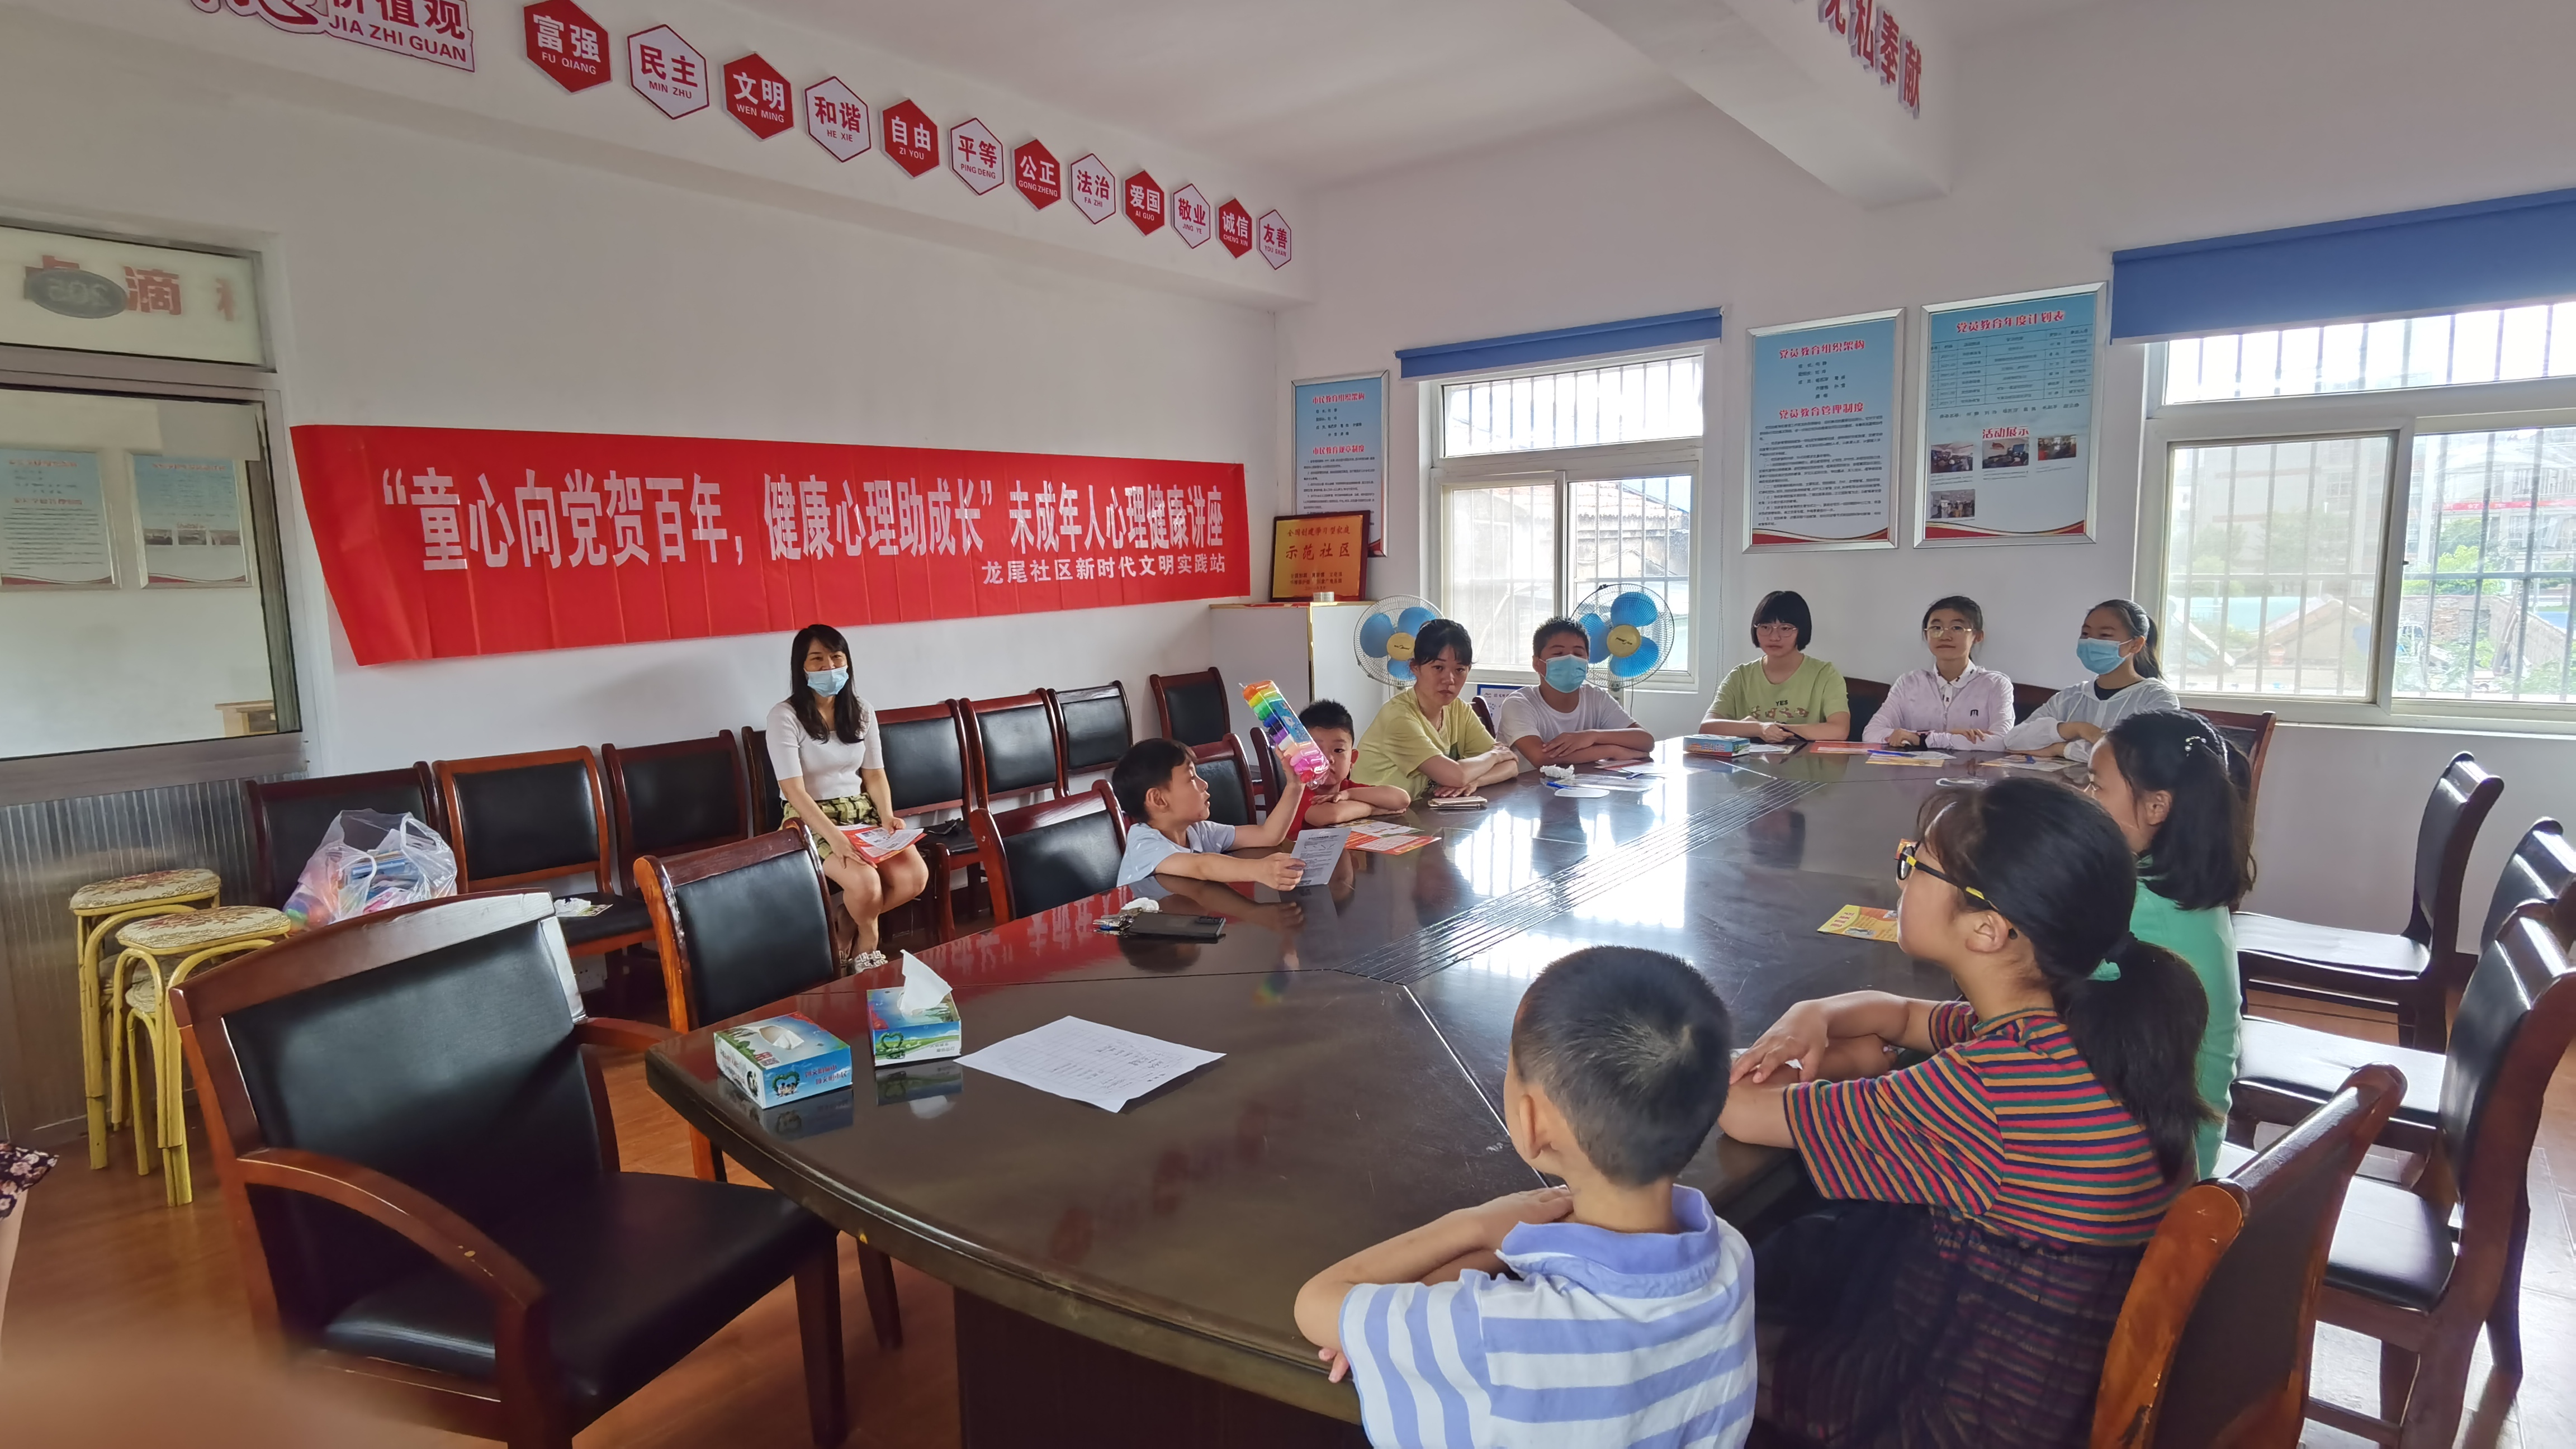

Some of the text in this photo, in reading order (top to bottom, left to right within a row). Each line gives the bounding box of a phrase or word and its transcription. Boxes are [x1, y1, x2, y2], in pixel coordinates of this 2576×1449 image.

[329, 15, 466, 62] JIA ZHI GUAN
[533, 14, 601, 63] 富强
[542, 52, 596, 75] FU QIANG
[640, 44, 698, 87] 民主
[649, 80, 692, 99] MIN ZHU
[733, 72, 785, 111] 文明
[736, 104, 784, 123] WEN MING
[814, 96, 861, 133] 和谐
[827, 129, 853, 143] HE XIE
[892, 116, 931, 152] 自由
[899, 148, 924, 160] ZI YOU
[958, 134, 997, 169] 平等
[960, 163, 996, 179] PING DENG
[1020, 155, 1056, 186] 公正
[1019, 179, 1058, 197] GONG ZHENG
[1077, 169, 1110, 200] 法治
[1093, 199, 1103, 207] ZHI
[1130, 184, 1161, 214] 爱国
[1178, 198, 1206, 226] 敬业
[1182, 224, 1194, 233] JING
[1222, 211, 1249, 239] 诚信
[1263, 224, 1287, 249] 友善
[1223, 234, 1239, 244] CHENG
[1957, 310, 2065, 333] 党员教育年度计划表
[1779, 340, 1865, 359] 党员教育组织架构
[1779, 402, 1864, 419] 党员教育管理制度
[1982, 426, 2029, 439] 活动展示
[1008, 479, 1225, 555] 未成年人心理健康讲座
[1286, 542, 1351, 560] 示范社区
[982, 553, 1226, 585] 龙尾社区新时代文明实践站
